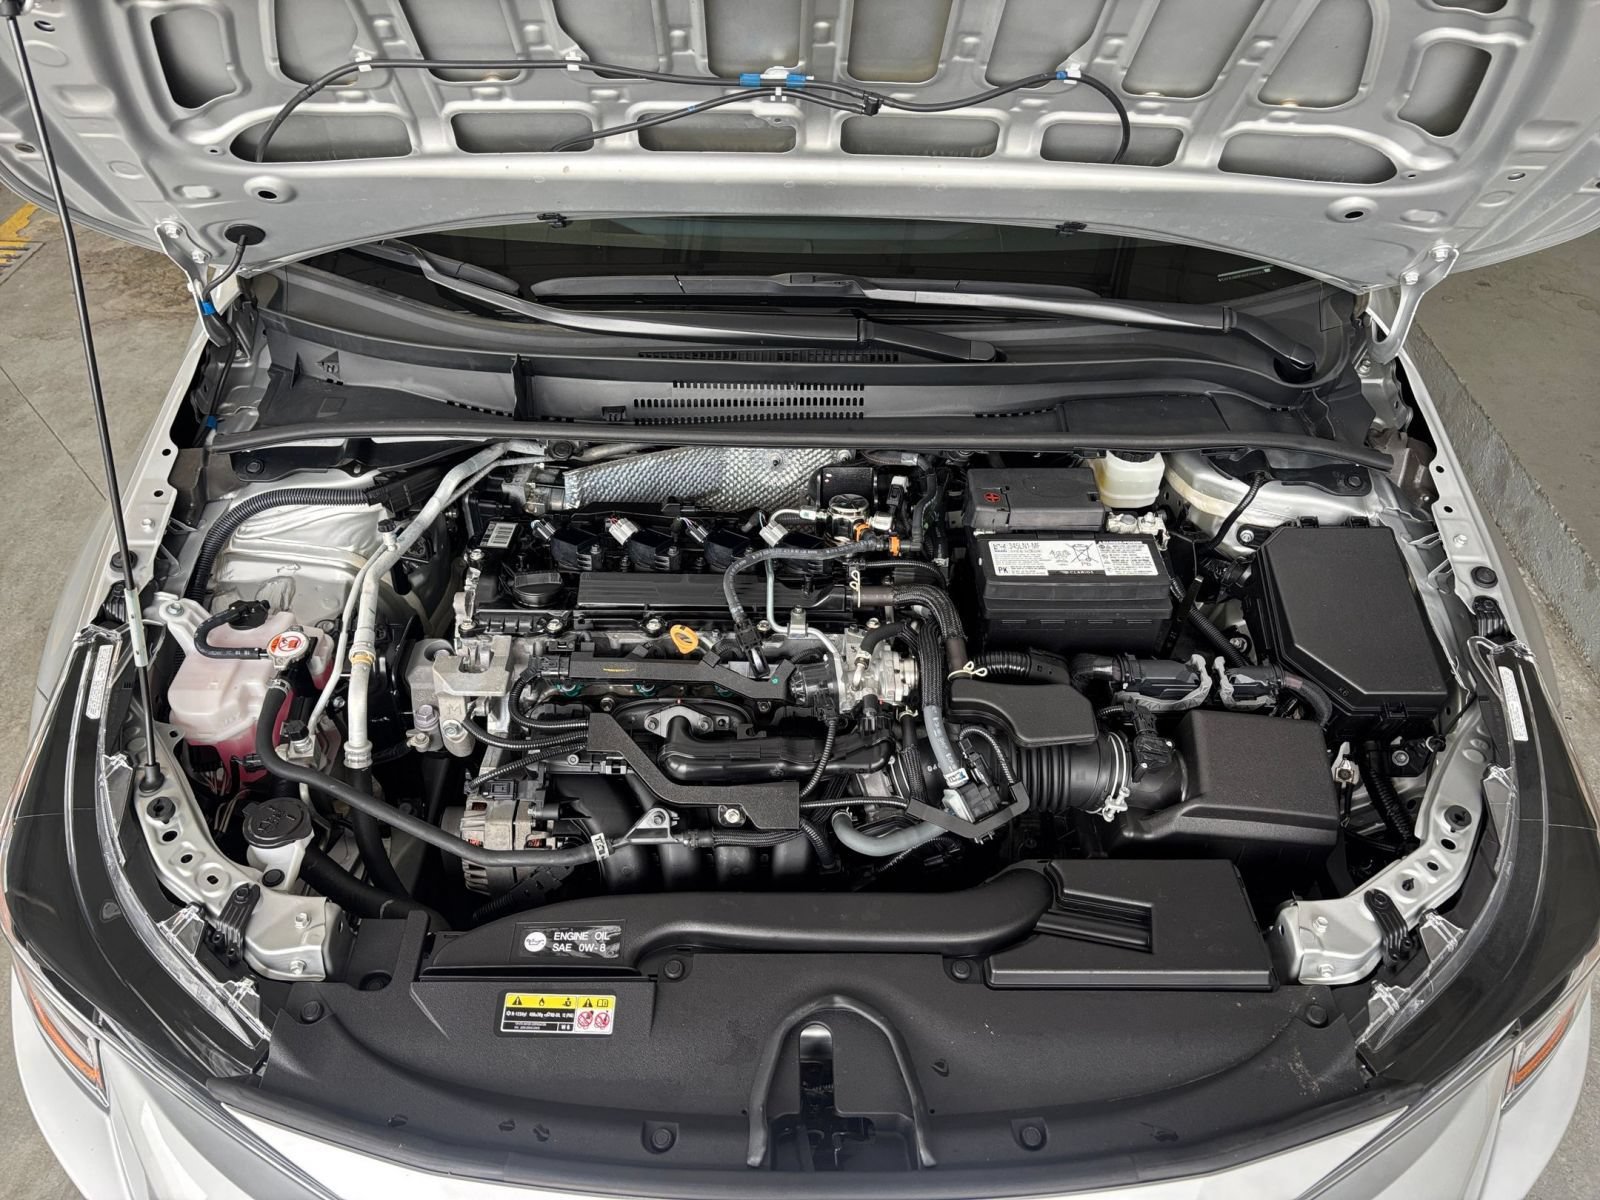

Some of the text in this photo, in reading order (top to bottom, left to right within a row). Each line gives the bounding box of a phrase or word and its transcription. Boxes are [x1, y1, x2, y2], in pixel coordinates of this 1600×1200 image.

[998, 566, 1009, 574] PK
[553, 931, 610, 941] ENGINE OIL
[552, 943, 606, 952] SAE 0W-8
